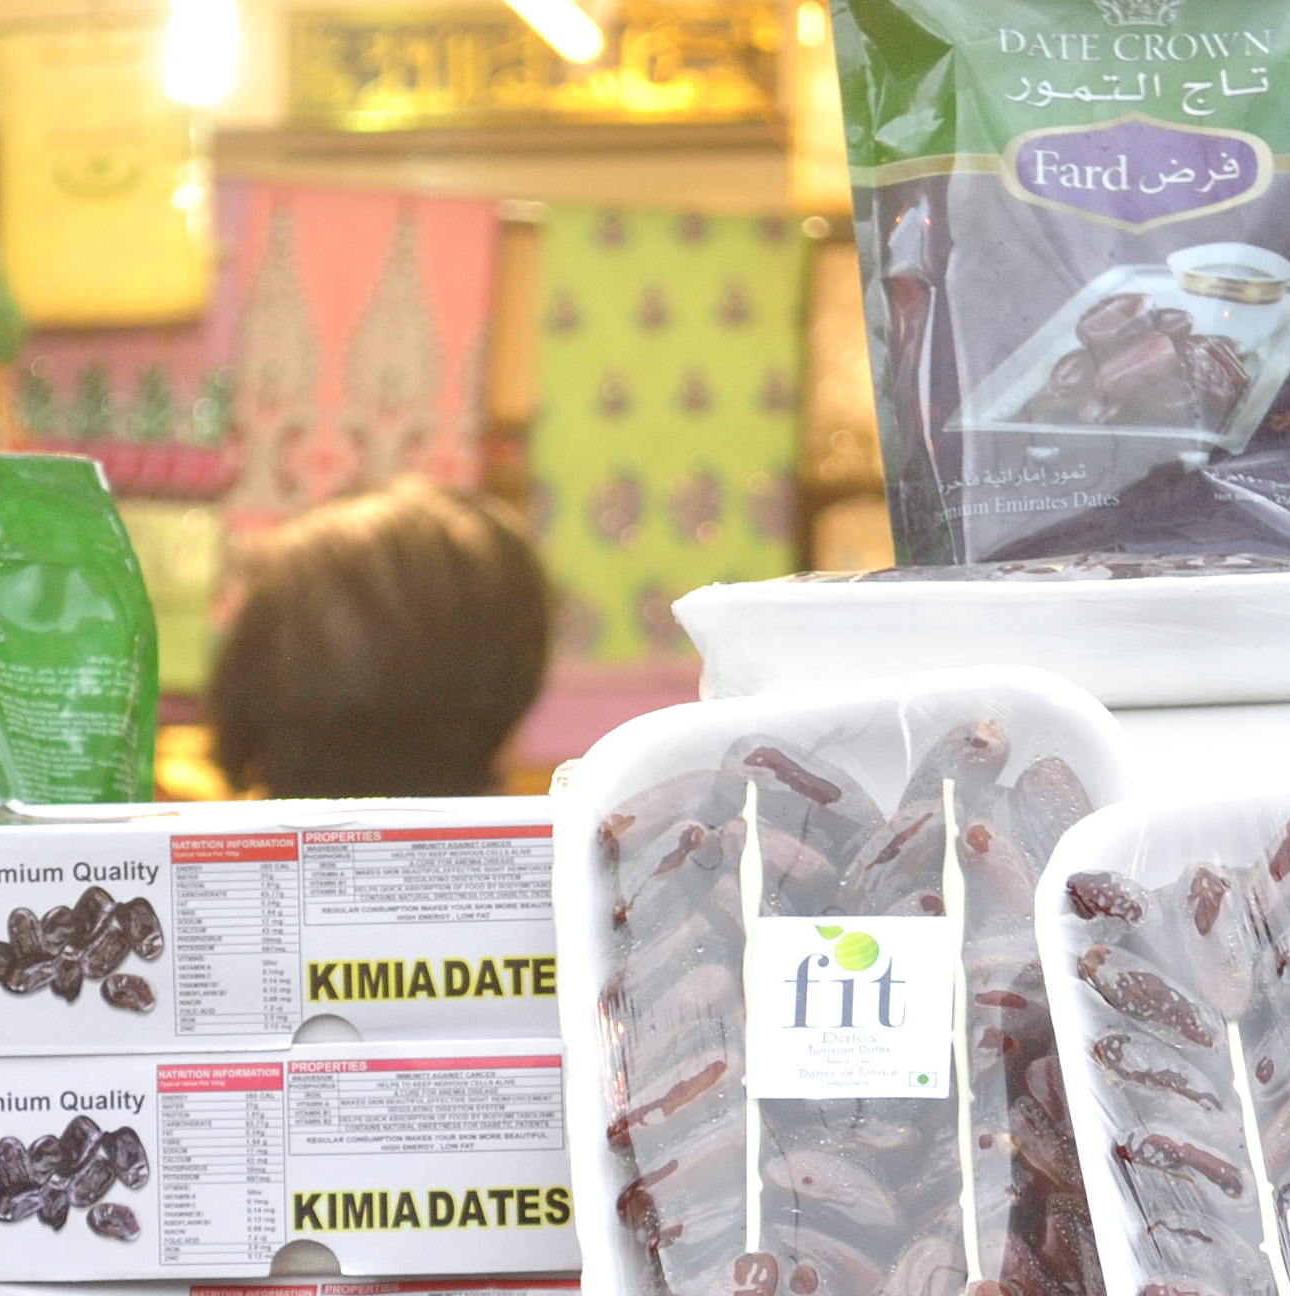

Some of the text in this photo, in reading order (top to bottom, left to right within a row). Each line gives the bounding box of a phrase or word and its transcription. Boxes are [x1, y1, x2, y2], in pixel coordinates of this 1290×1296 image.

[999, 28, 1271, 61] DATE CROWN
[1004, 67, 1269, 116] تاج التمور
[1033, 150, 1130, 191] Fard
[1139, 152, 1241, 194] فرض
[1050, 464, 1086, 484] تمور
[995, 495, 1068, 513] Emirates
[1073, 491, 1120, 508] Dates
[172, 838, 294, 850] NATRITION INFORMATION
[305, 831, 382, 843] PROPERTIES
[73, 861, 159, 885] Quality
[308, 957, 557, 1001] KIMIA DATE
[782, 953, 906, 1028] fit
[823, 1032, 877, 1043] Dates
[808, 1045, 891, 1055] Tunisian Dates
[158, 1068, 279, 1079] NATRITION INFORMATION
[290, 1061, 367, 1073] PROPERTIES
[840, 1068, 853, 1077] de
[859, 1067, 897, 1077] Tunisie
[60, 1090, 145, 1115] Quality
[293, 1187, 571, 1231] KIMIA DATES
[324, 1283, 399, 1295] PROPERTIES
